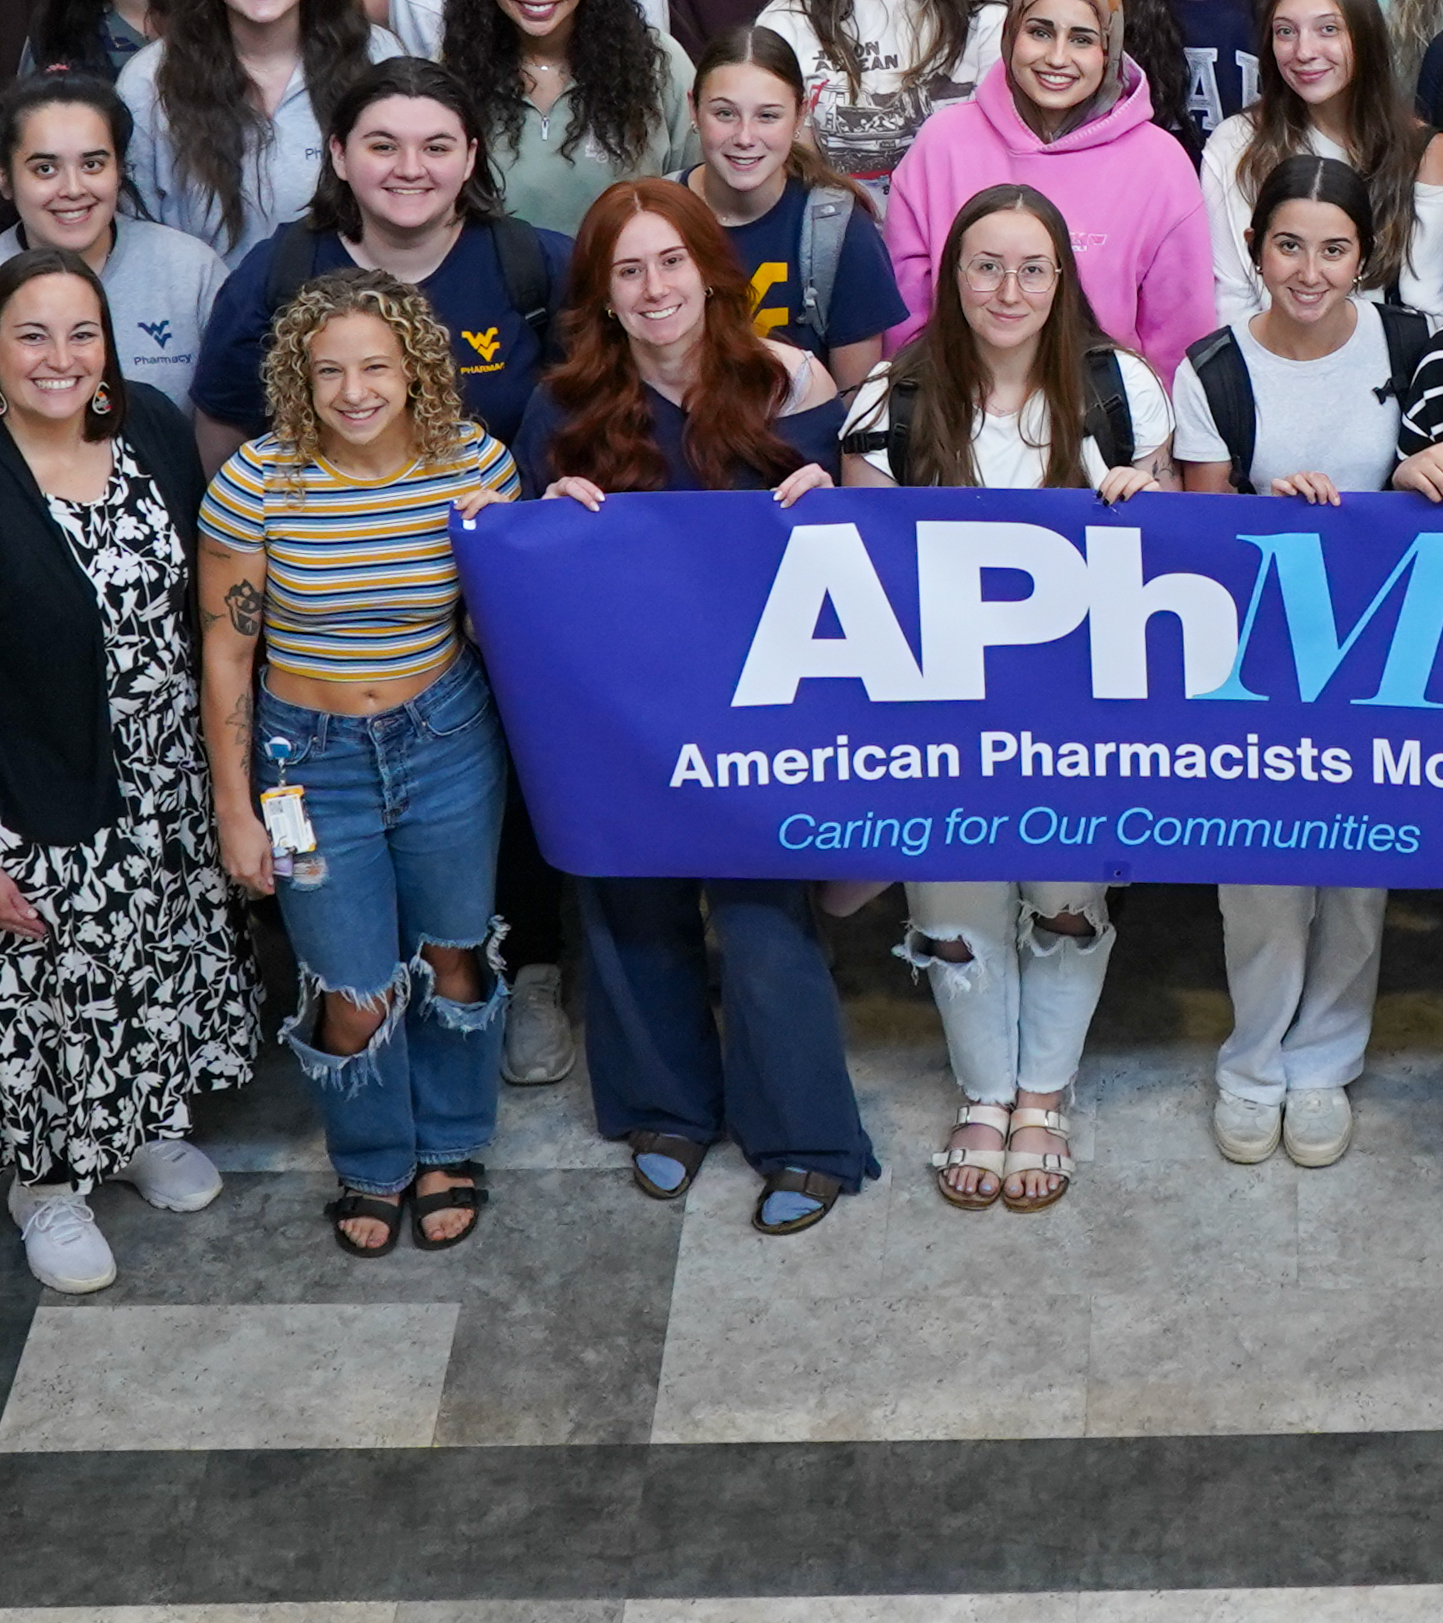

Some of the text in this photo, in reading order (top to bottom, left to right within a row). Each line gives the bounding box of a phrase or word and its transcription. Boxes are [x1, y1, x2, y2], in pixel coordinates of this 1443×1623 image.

[304, 147, 323, 161] Ph
[133, 354, 193, 366] Pharmacy
[669, 729, 960, 789] American
[980, 729, 1354, 784] Pharmacists
[778, 805, 1423, 858] Caring for Our Communities
